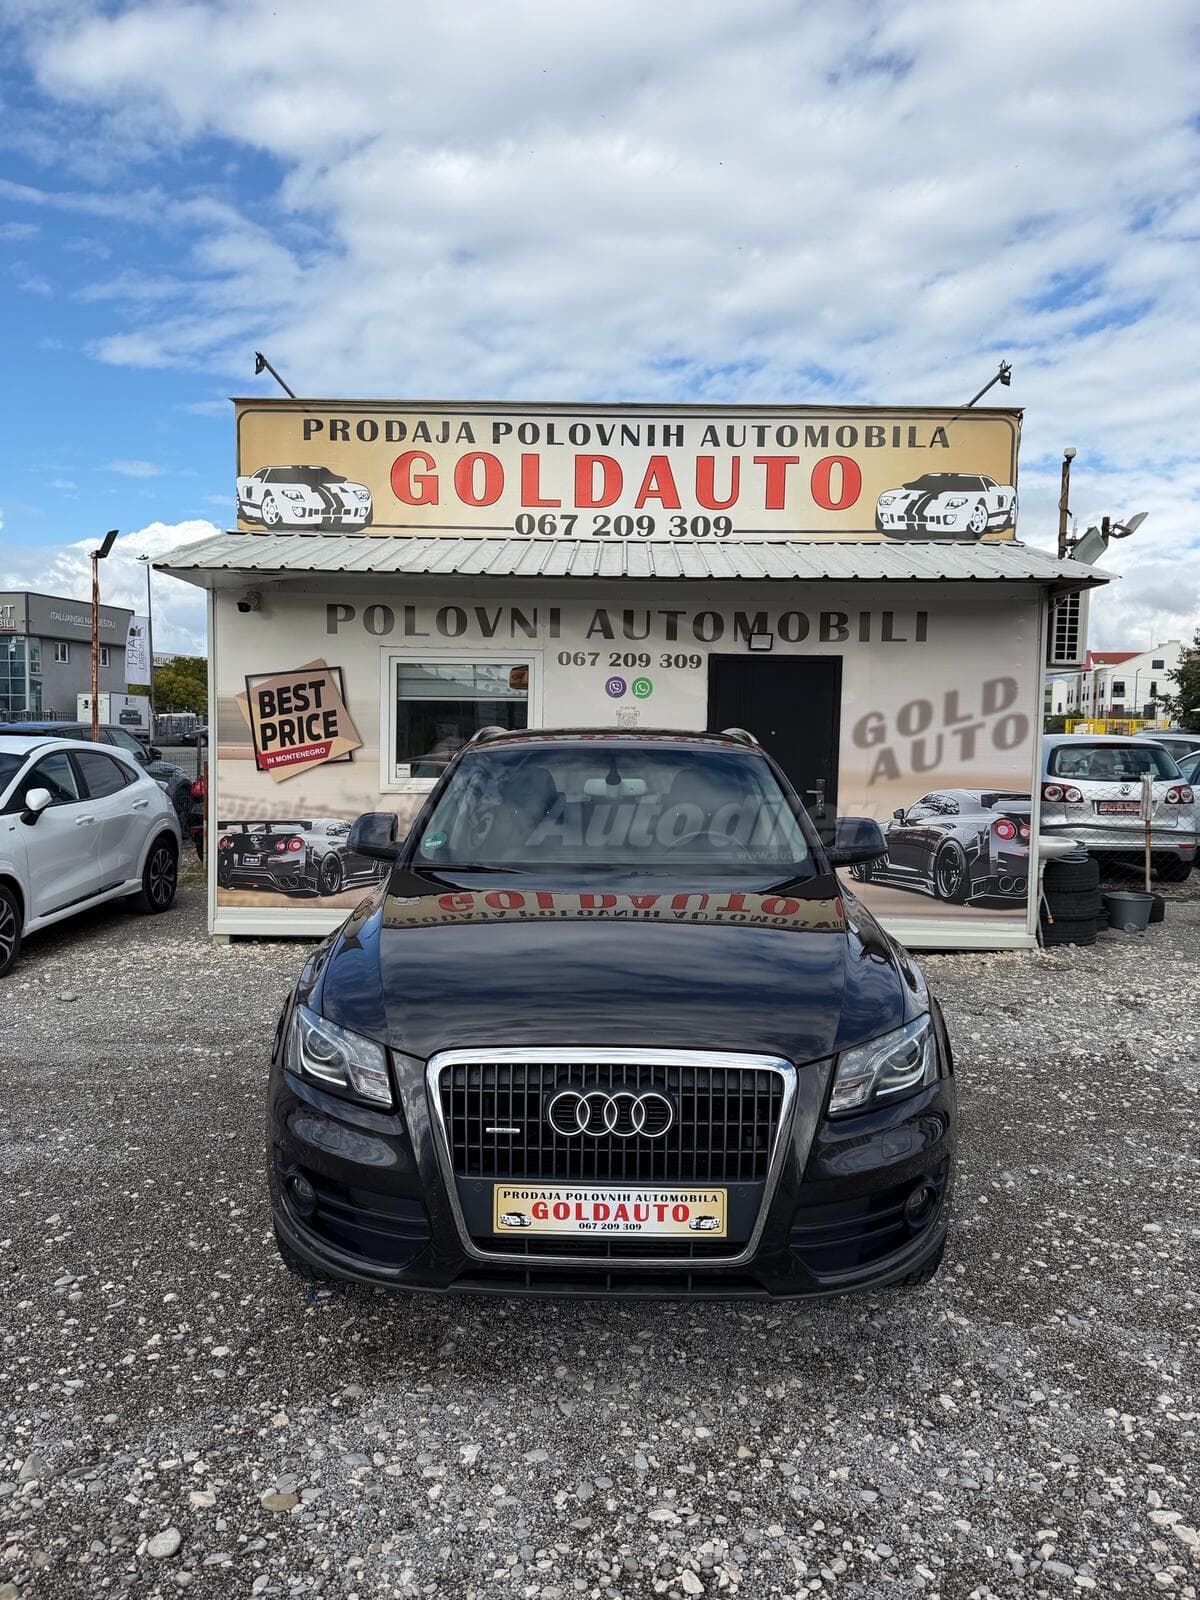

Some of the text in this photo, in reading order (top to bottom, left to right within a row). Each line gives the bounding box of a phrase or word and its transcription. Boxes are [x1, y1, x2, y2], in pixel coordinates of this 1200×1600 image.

[302, 418, 950, 449] PRODAJA POLOVNIH AUTOMOBILA
[390, 449, 862, 511] GOLDAUTO
[514, 513, 734, 538] 067 209 309
[326, 603, 928, 643] POLOVNI AUTOMOBILI
[557, 651, 702, 669] 067 209 309
[258, 679, 326, 719] BEST
[853, 676, 1018, 749] GOLD
[260, 709, 339, 751] PRICE
[276, 747, 326, 763] MONTENEGRO
[868, 712, 1029, 786] AUTO
[503, 1190, 718, 1203] PRODAJA POLOVNIH AUTOMOBILA
[531, 1201, 690, 1223] GOLDAUTO
[579, 1222, 642, 1231] 067 209 309
